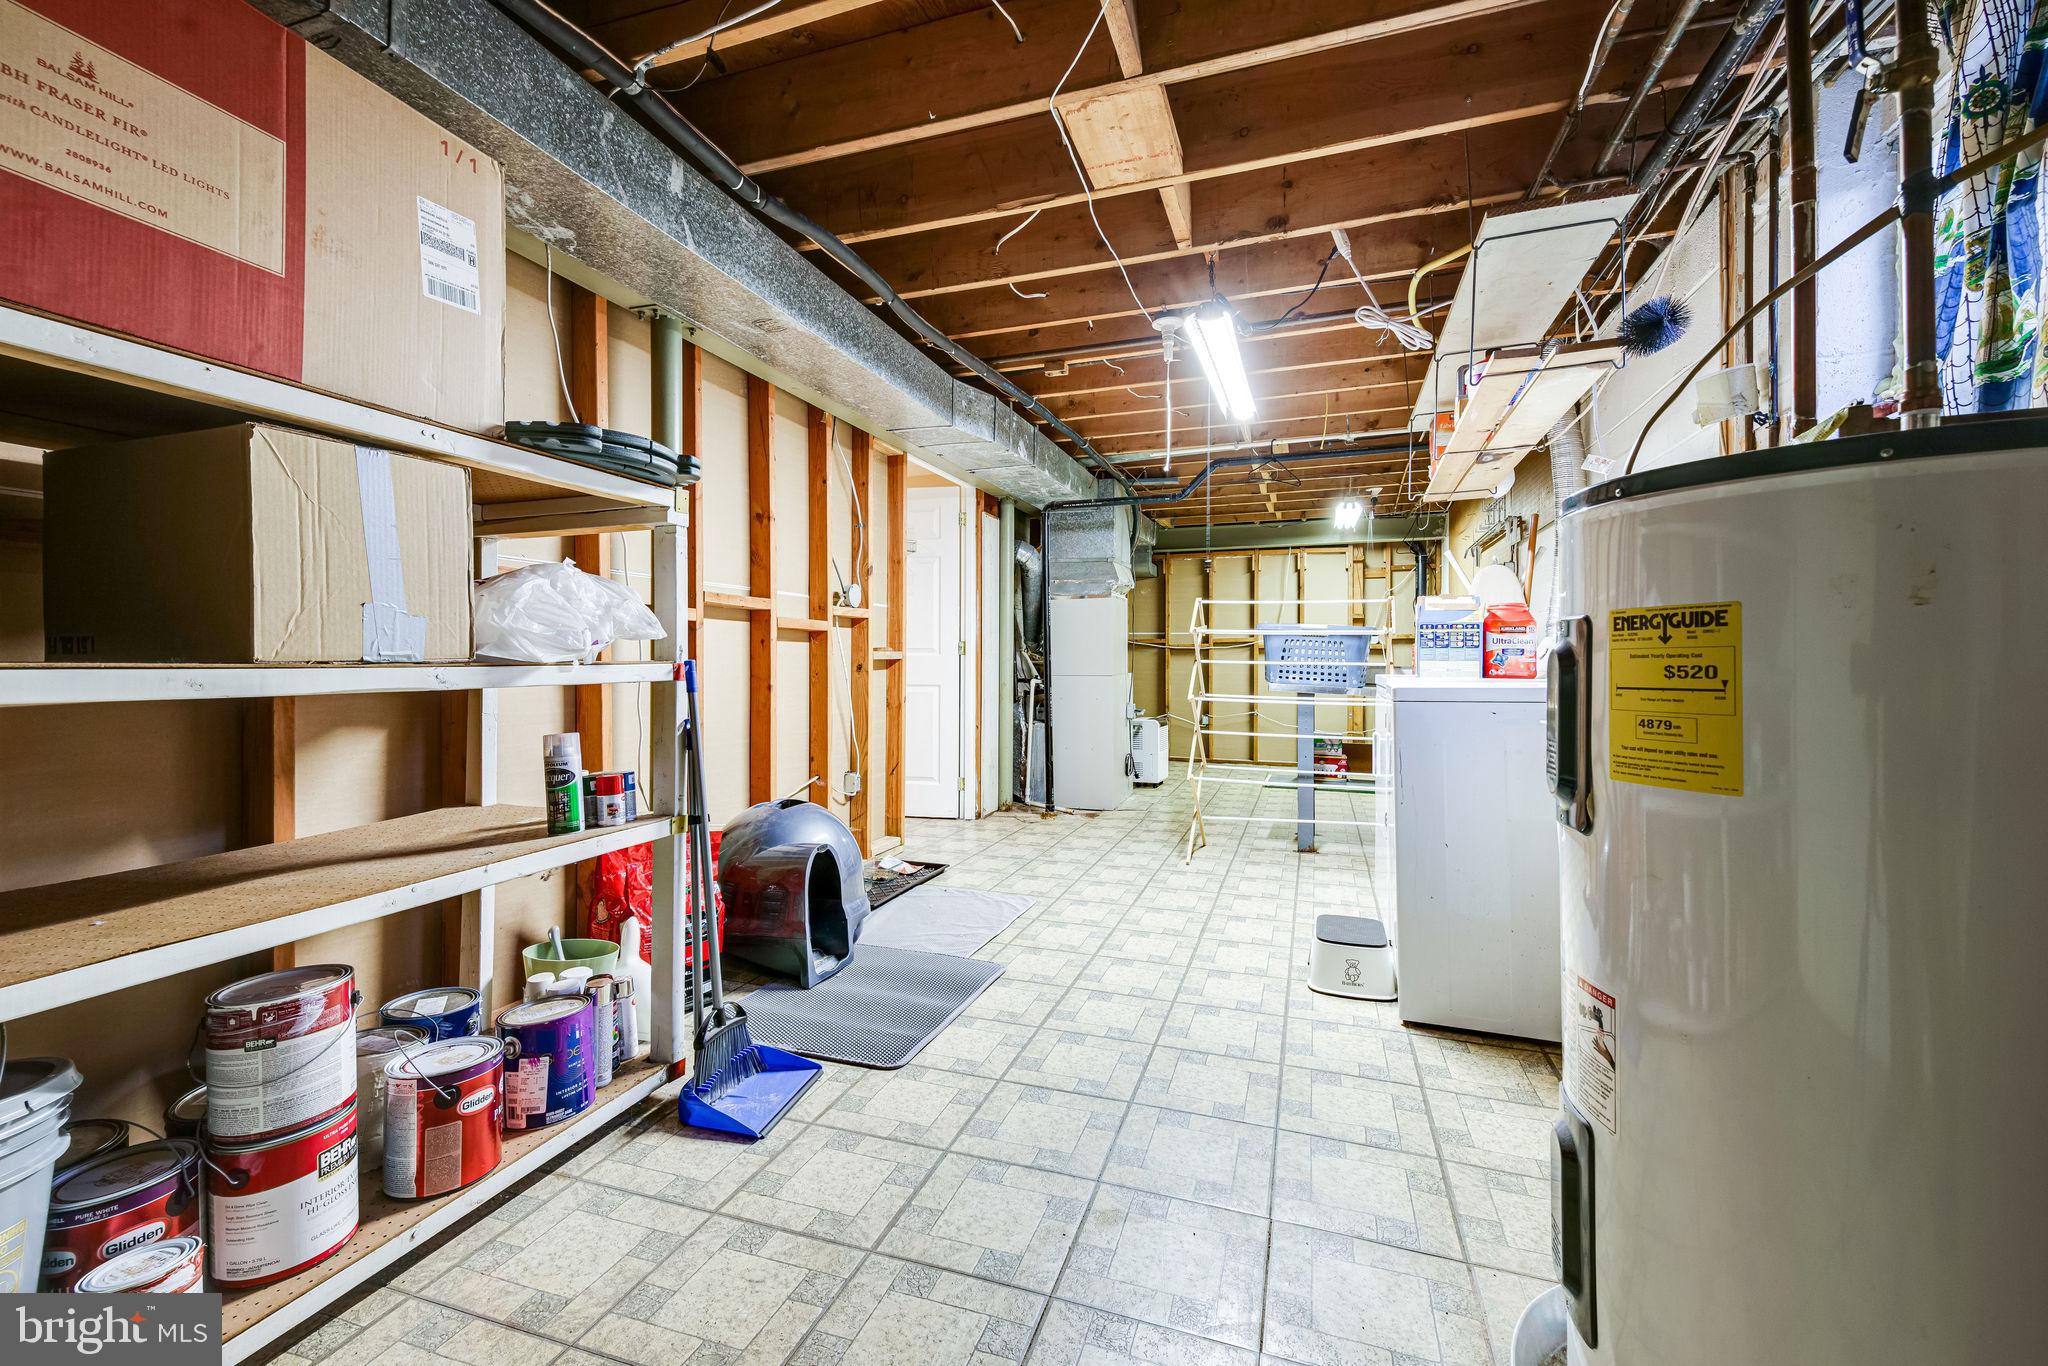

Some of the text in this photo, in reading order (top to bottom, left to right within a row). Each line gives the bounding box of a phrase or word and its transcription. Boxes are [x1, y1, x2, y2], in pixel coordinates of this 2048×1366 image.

[36, 57, 96, 92] BALSAM
[0, 62, 30, 86] BH
[35, 79, 106, 121] FRASER
[0, 93, 26, 110] ith
[152, 159, 179, 177] LED
[183, 173, 231, 200] LIGHTS
[65, 148, 112, 174] 2808936
[1613, 609, 1728, 632] ENERGYGUIDE
[1663, 664, 1718, 681] $520
[1638, 718, 1673, 731] 4879
[1583, 983, 1613, 1004] DANGER
[245, 1039, 266, 1048] BEHR
[320, 1138, 352, 1167] BEHR
[320, 1153, 350, 1176] PREMIUM
[74, 1212, 94, 1221] PURE
[95, 1204, 119, 1215] WHITE
[105, 1226, 164, 1256] Glidden
